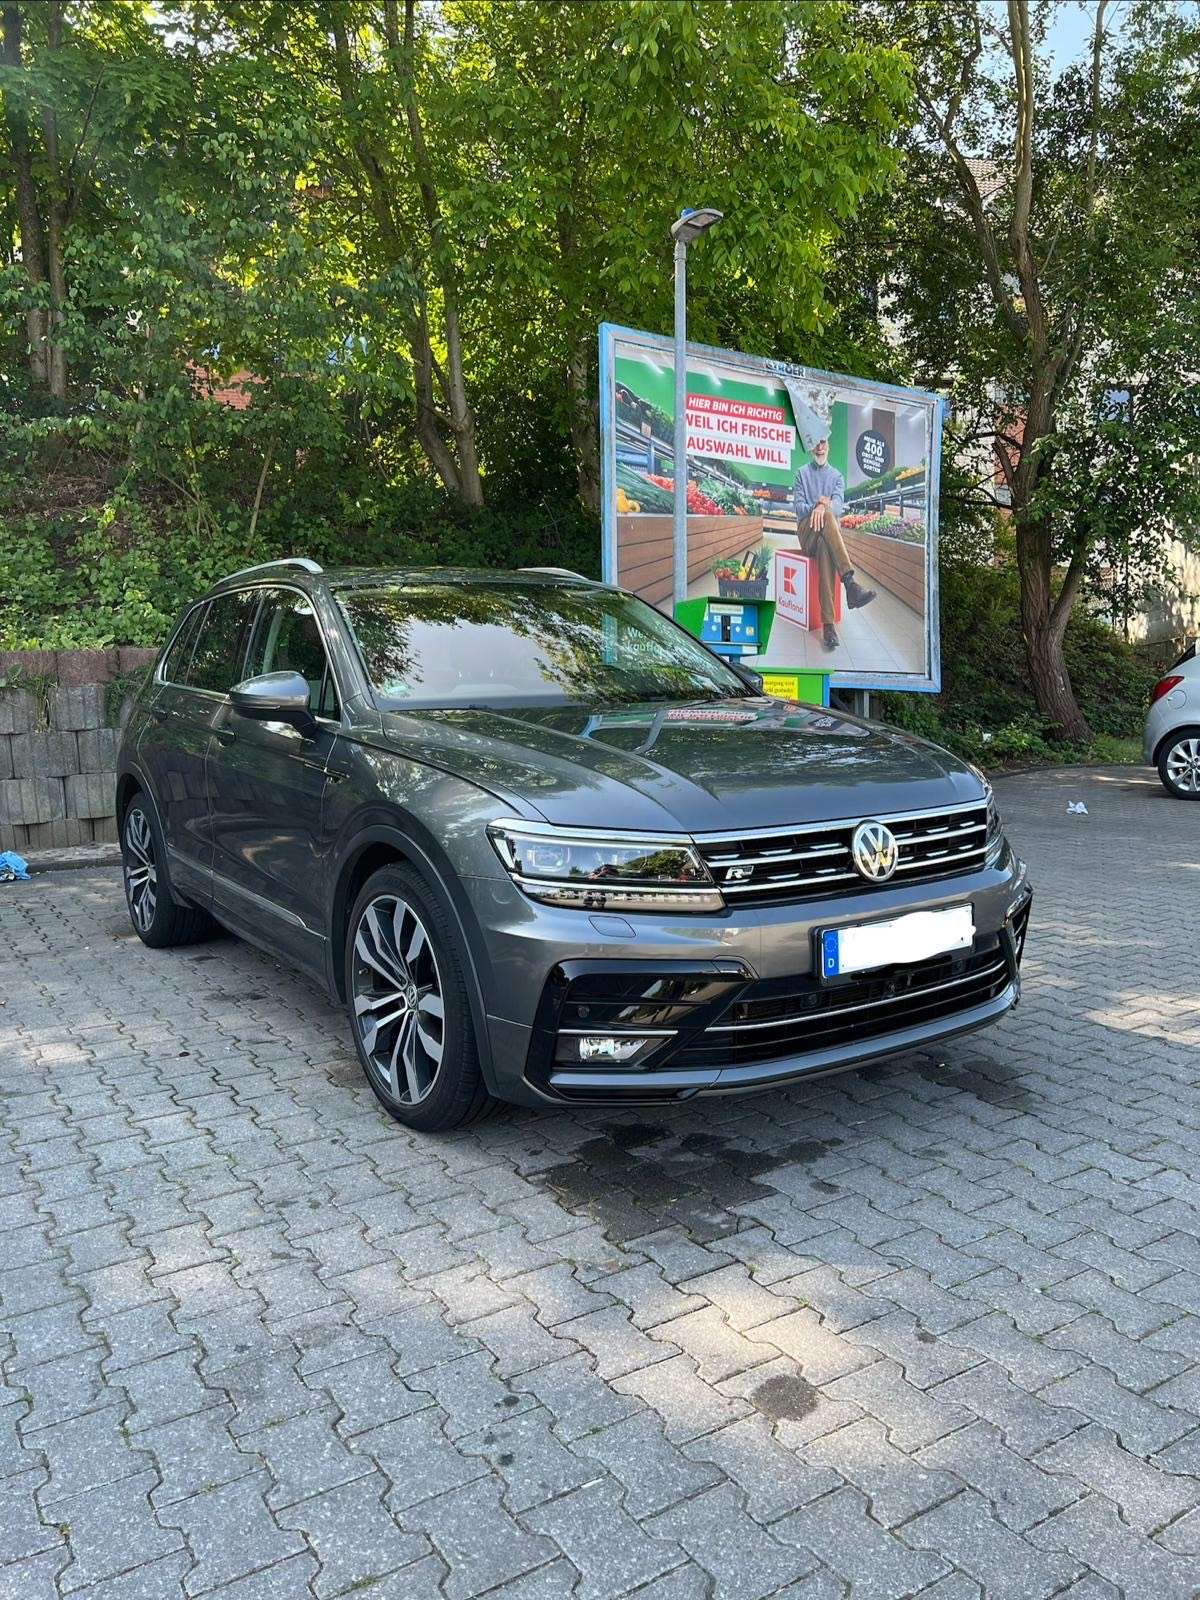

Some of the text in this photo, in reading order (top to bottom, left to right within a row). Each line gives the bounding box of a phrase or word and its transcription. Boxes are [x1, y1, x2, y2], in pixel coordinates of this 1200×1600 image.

[688, 397, 783, 421] HIER BIN ICH RICHTIG
[717, 418, 739, 435] ICH
[741, 422, 792, 444] FRISCHE
[687, 435, 788, 465] AUSWAHL WILL.
[864, 442, 883, 457] 400
[778, 596, 804, 615] Kaufland
[828, 958, 835, 969] D
